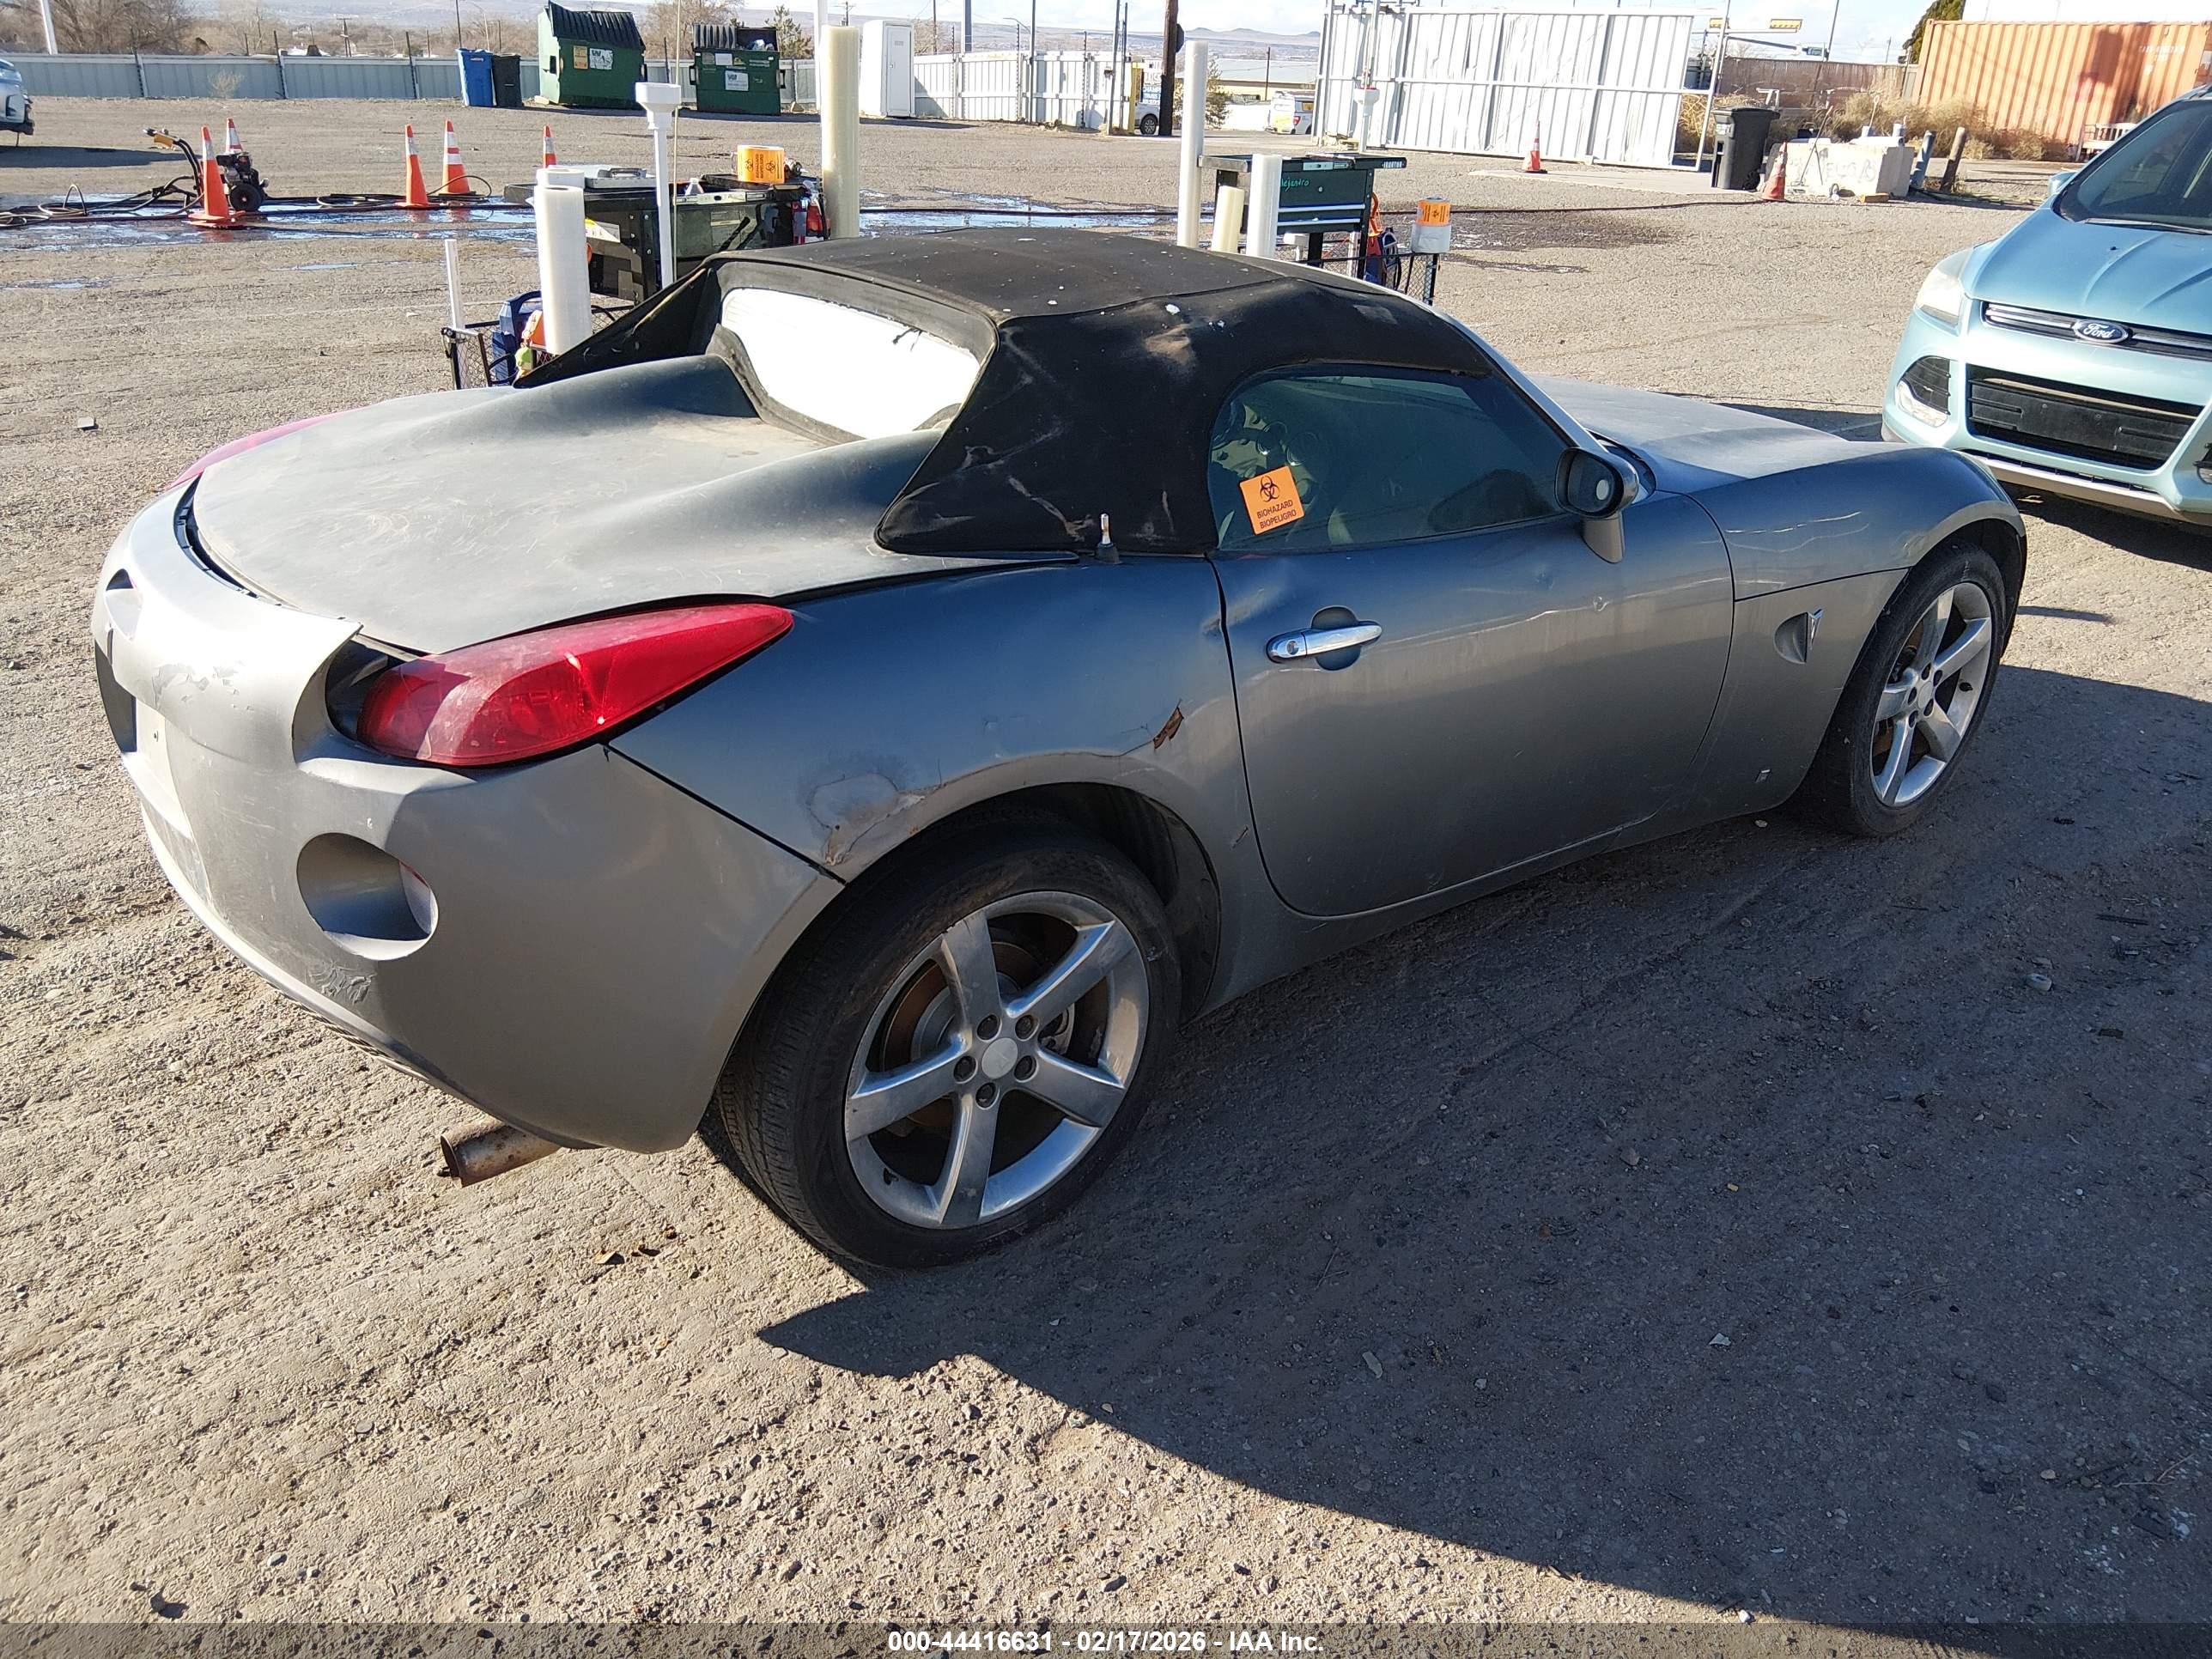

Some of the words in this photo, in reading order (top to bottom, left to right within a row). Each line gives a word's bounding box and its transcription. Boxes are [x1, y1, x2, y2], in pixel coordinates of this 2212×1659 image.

[1281, 176, 1310, 192] lejandro
[2083, 323, 2116, 339] Ford
[1257, 500, 1293, 519] BIOHAZARD
[1260, 509, 1297, 529] BIOPELIGRO
